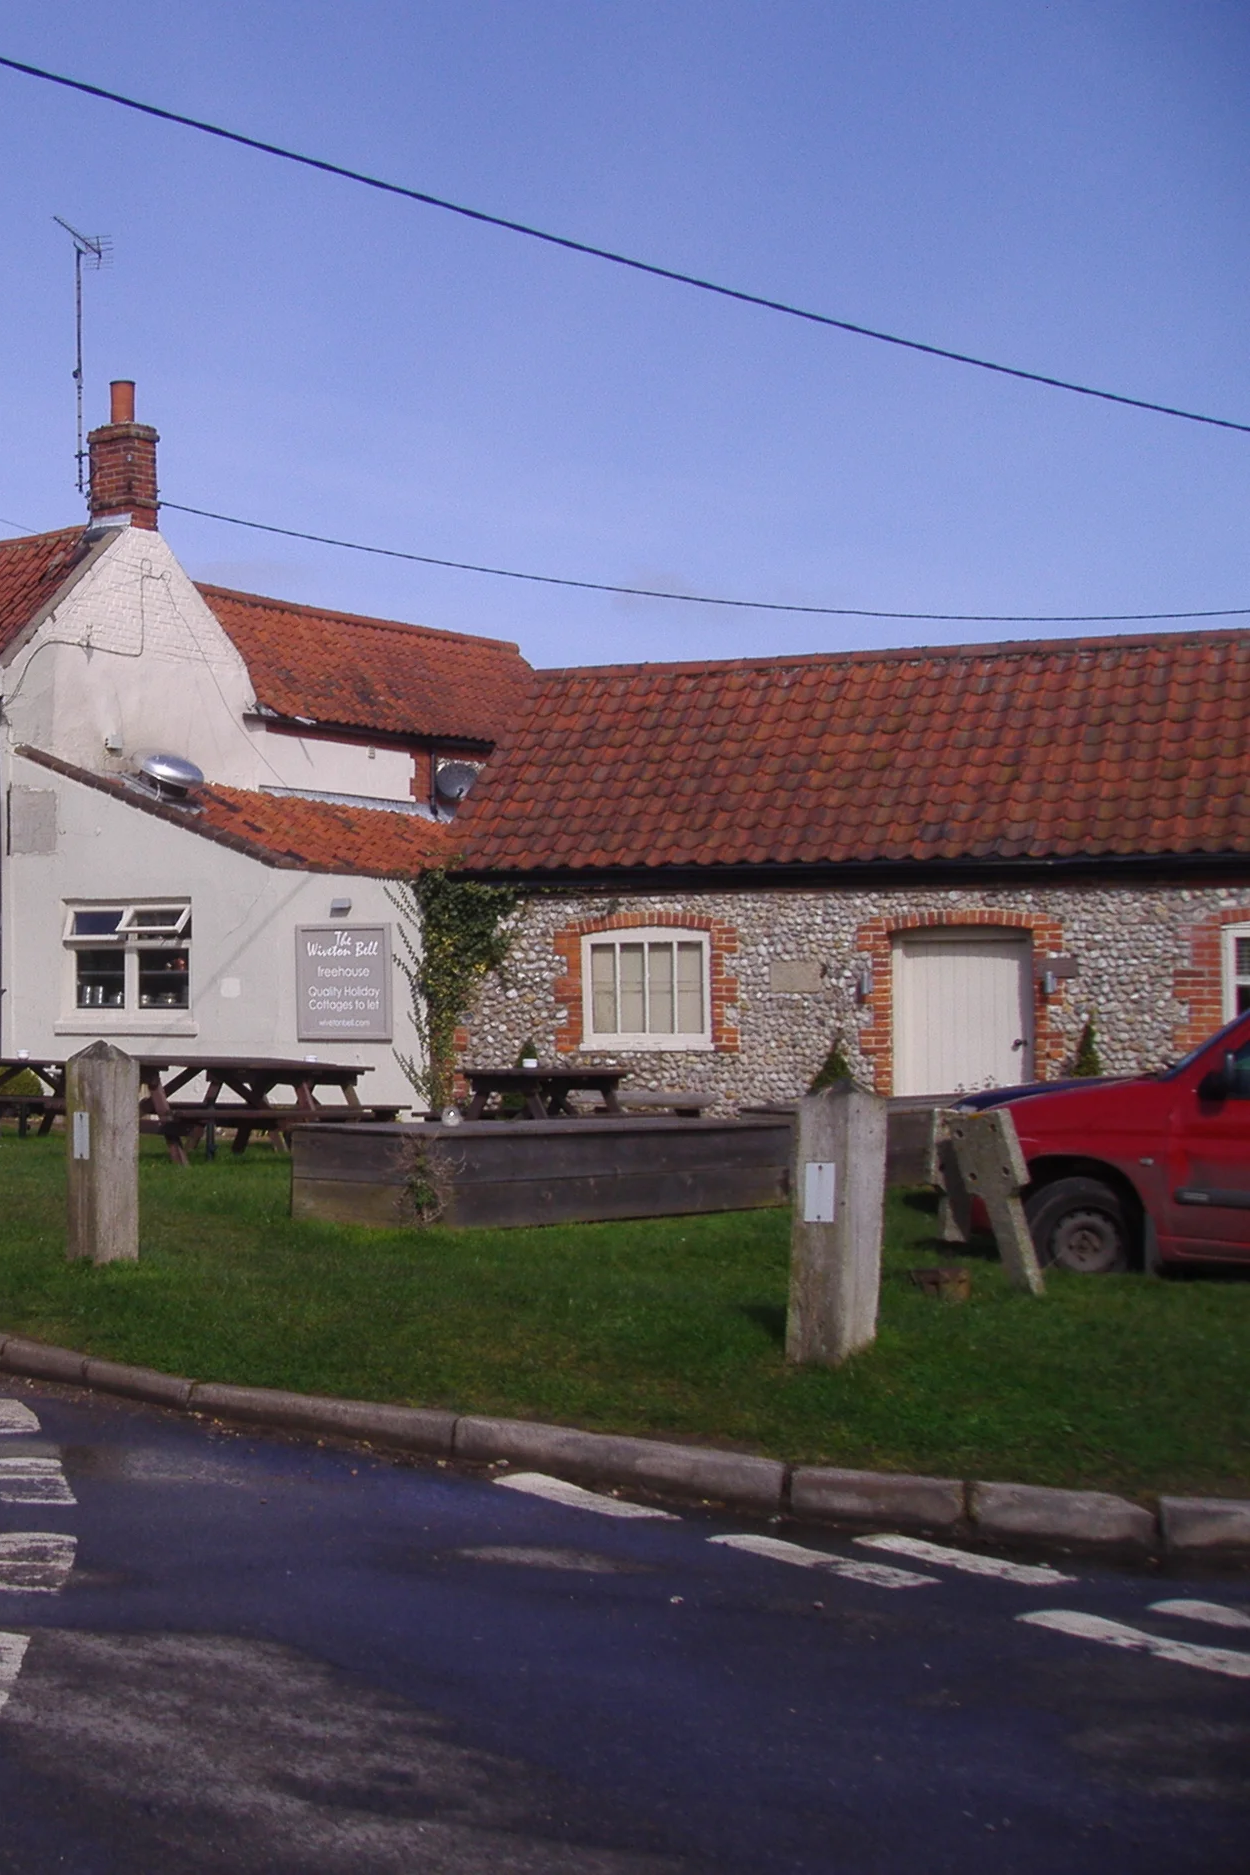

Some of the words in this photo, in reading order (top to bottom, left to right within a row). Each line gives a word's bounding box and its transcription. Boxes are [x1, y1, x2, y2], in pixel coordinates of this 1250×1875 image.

[334, 930, 352, 946] The
[307, 941, 352, 957] Wiveton
[355, 941, 379, 957] Bell
[308, 985, 342, 999] Quality
[344, 985, 381, 999] Holiday
[308, 998, 353, 1012] Cottages
[355, 999, 365, 1010] to
[367, 999, 380, 1010] let
